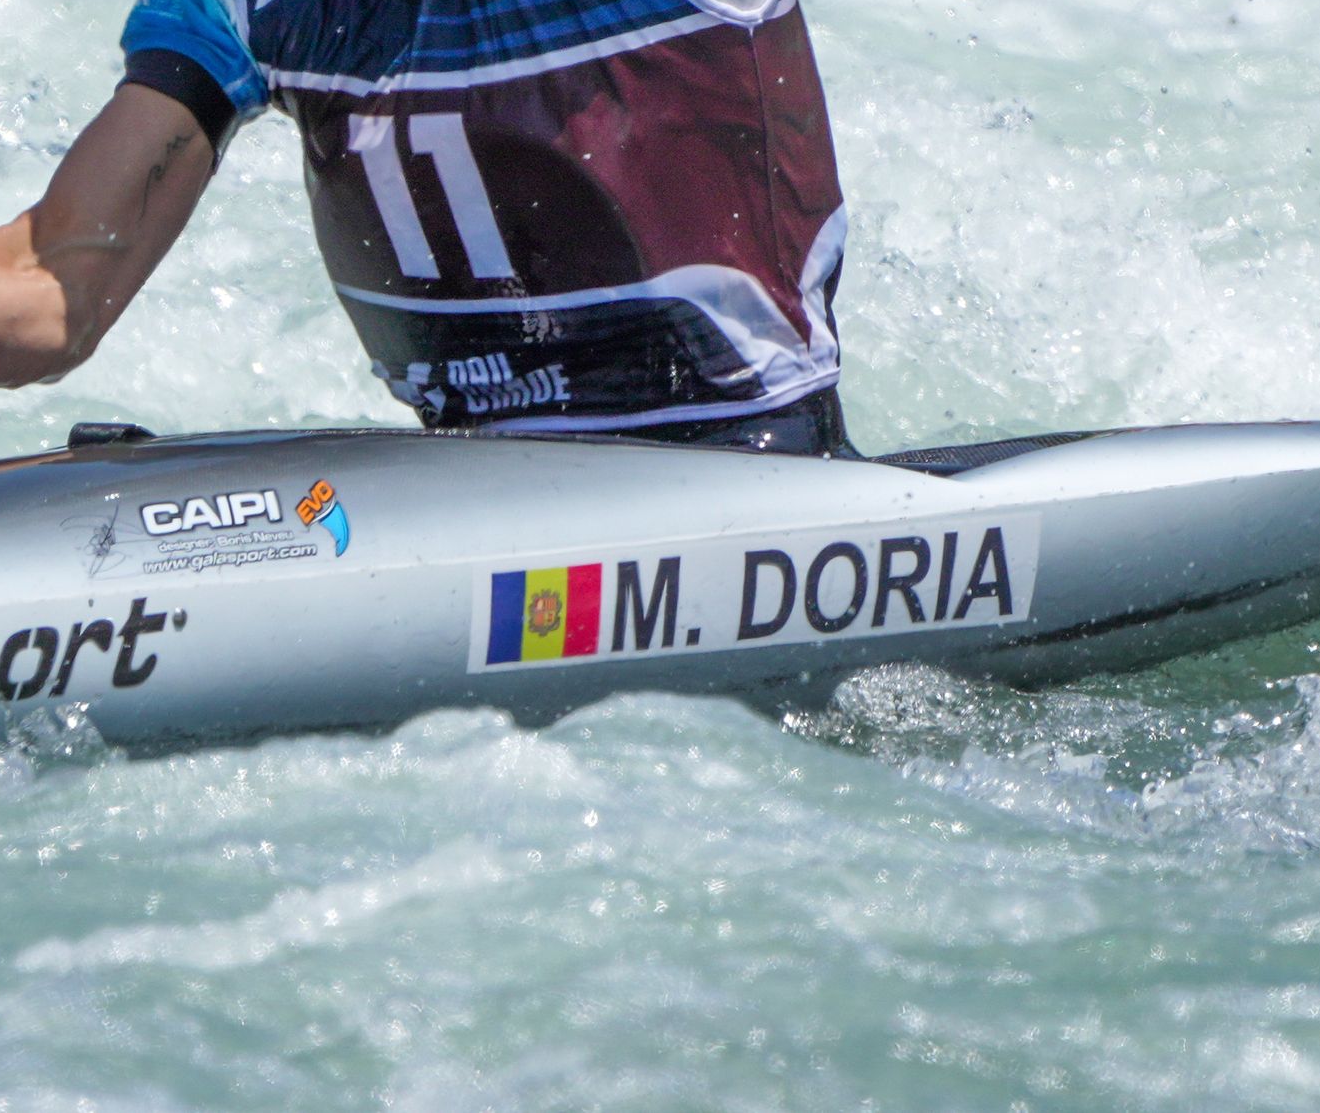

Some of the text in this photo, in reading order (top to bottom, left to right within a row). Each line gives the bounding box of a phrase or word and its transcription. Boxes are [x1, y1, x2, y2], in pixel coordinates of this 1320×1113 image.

[348, 112, 515, 279] 11
[141, 490, 282, 536] CAIPI
[295, 479, 335, 527] EVO
[143, 544, 317, 574] www.galasport.com
[217, 533, 252, 548] Boris
[252, 529, 295, 543] Neveu
[611, 527, 1014, 652] M. DORIA
